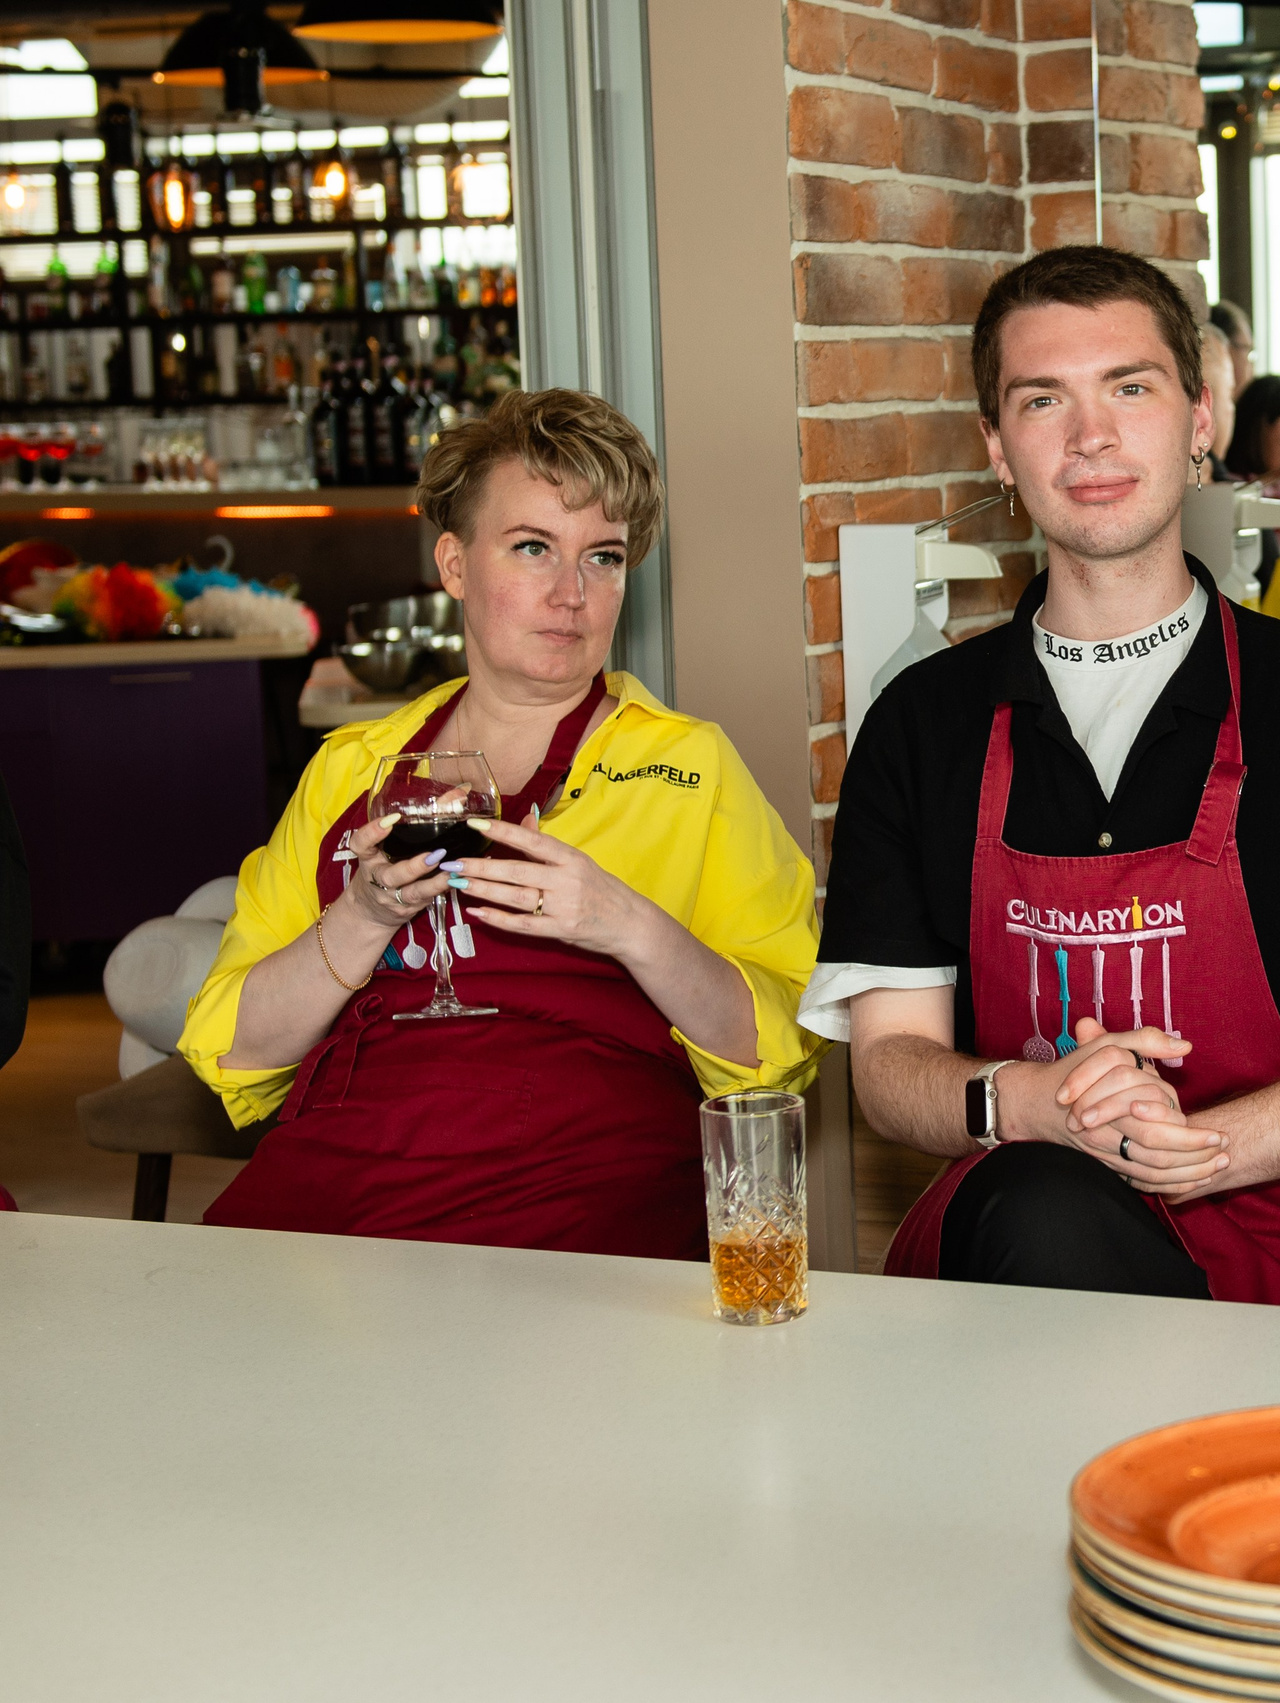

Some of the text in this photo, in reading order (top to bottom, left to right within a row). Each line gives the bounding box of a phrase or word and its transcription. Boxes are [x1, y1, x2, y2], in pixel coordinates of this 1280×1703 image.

[1043, 612, 1190, 664] Los Angeles
[607, 764, 701, 785] LAGERFELD
